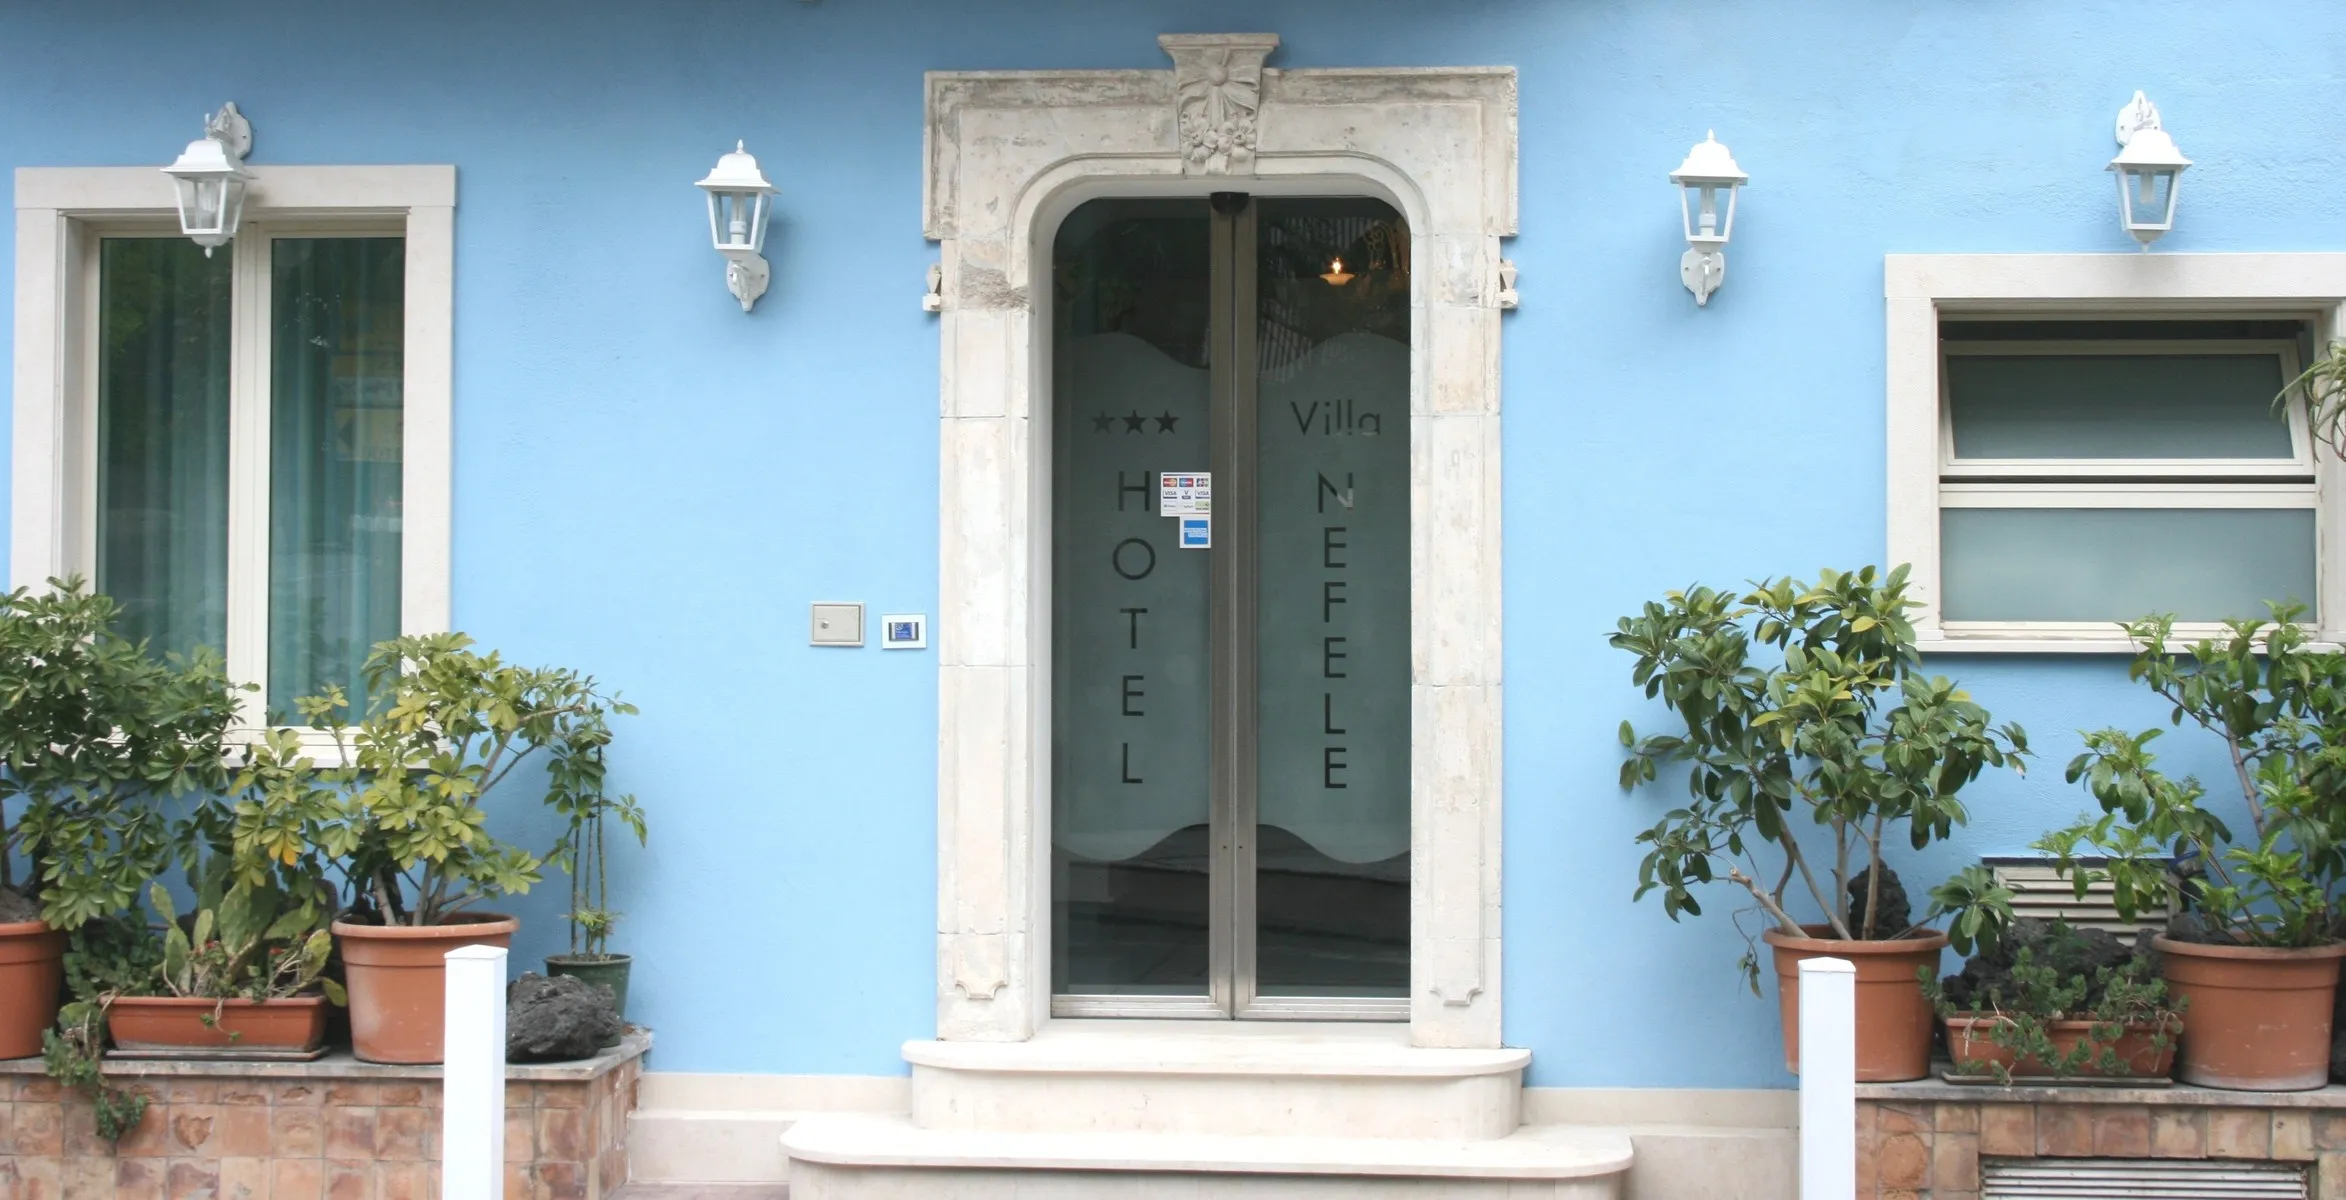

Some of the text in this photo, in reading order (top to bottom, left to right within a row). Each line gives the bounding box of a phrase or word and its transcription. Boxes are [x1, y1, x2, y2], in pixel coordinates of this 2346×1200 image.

[1289, 399, 1381, 437] Villa
[1112, 470, 1156, 785] HOTEL
[1317, 471, 1354, 789] NEFELE
